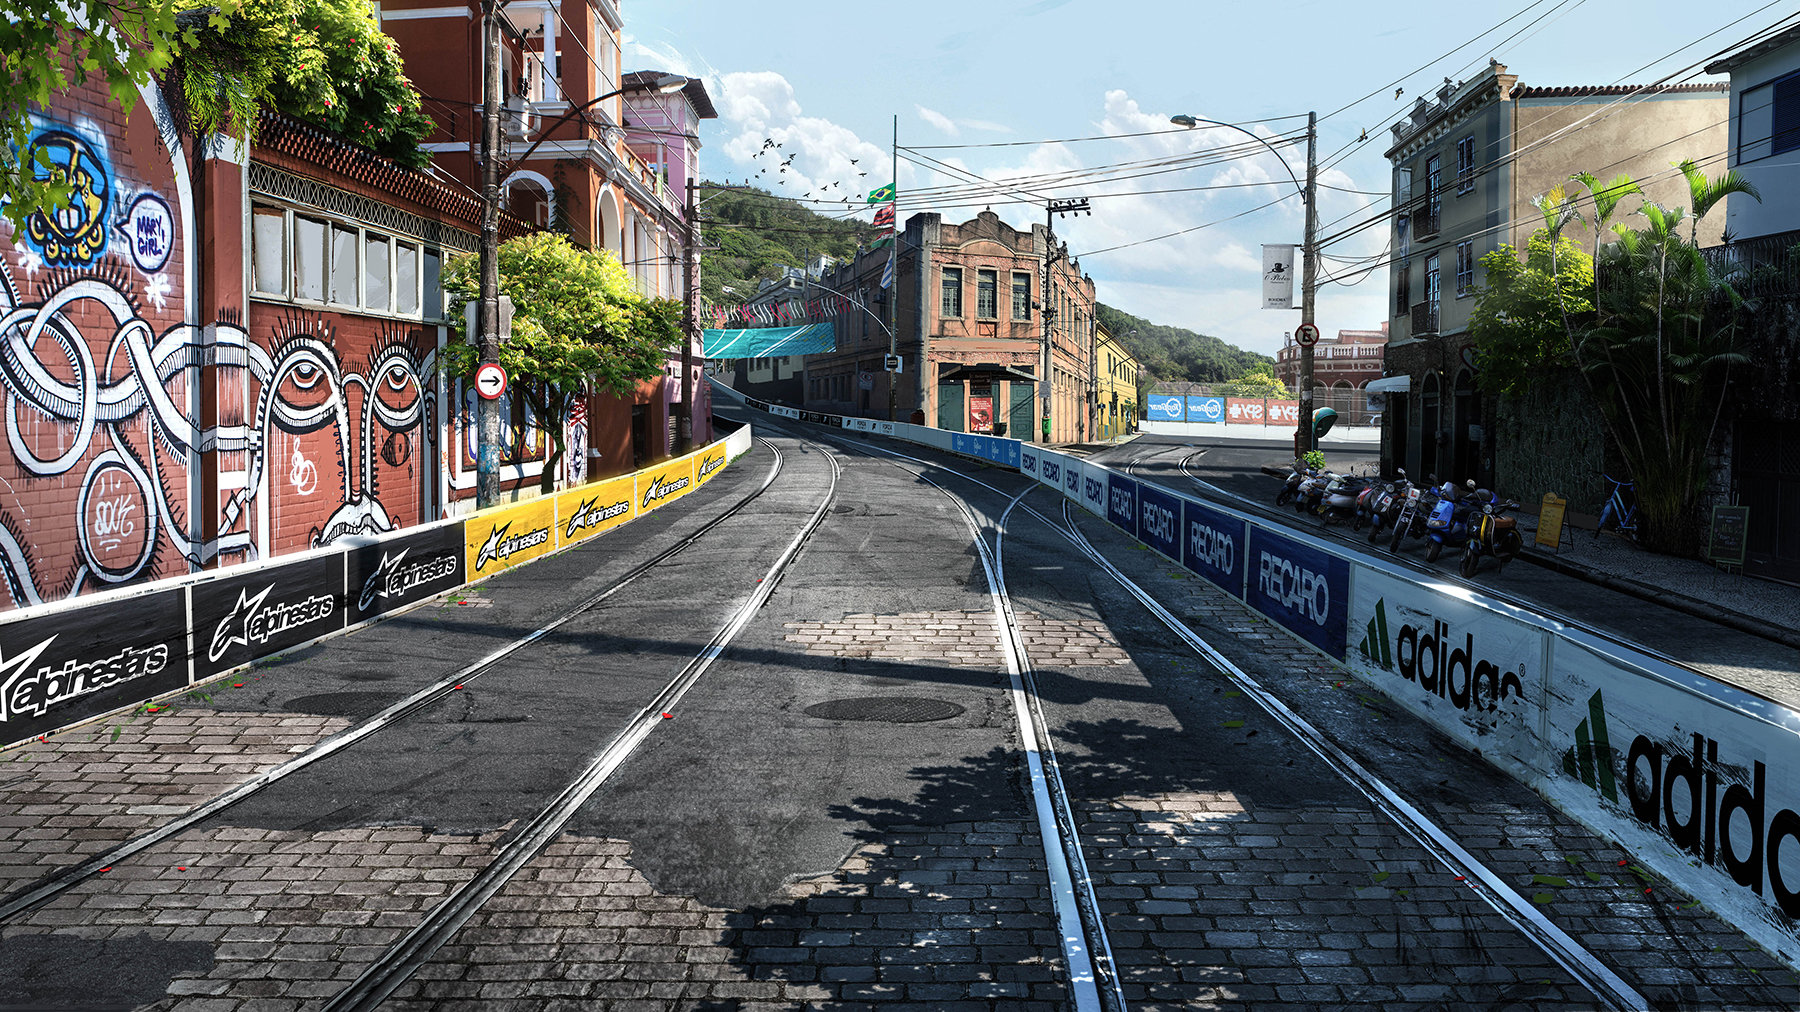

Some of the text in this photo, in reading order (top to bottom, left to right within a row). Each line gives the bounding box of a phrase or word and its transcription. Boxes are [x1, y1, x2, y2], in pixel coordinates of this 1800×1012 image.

[137, 215, 162, 238] MARY
[1022, 453, 1036, 472] RECARO
[1043, 460, 1060, 483] RECARO
[657, 476, 689, 499] alpinestars
[1086, 477, 1103, 505] RECARO
[1111, 486, 1132, 520] RECARO
[586, 500, 629, 528] alpinestars
[1143, 500, 1174, 543] RECARO
[498, 527, 549, 560] alpinestars
[1191, 520, 1234, 575] RECARO
[389, 555, 457, 597] alpinestars
[1259, 550, 1329, 626] RECARO
[249, 594, 334, 644] alpinestars
[10, 643, 169, 717] alpinestars
